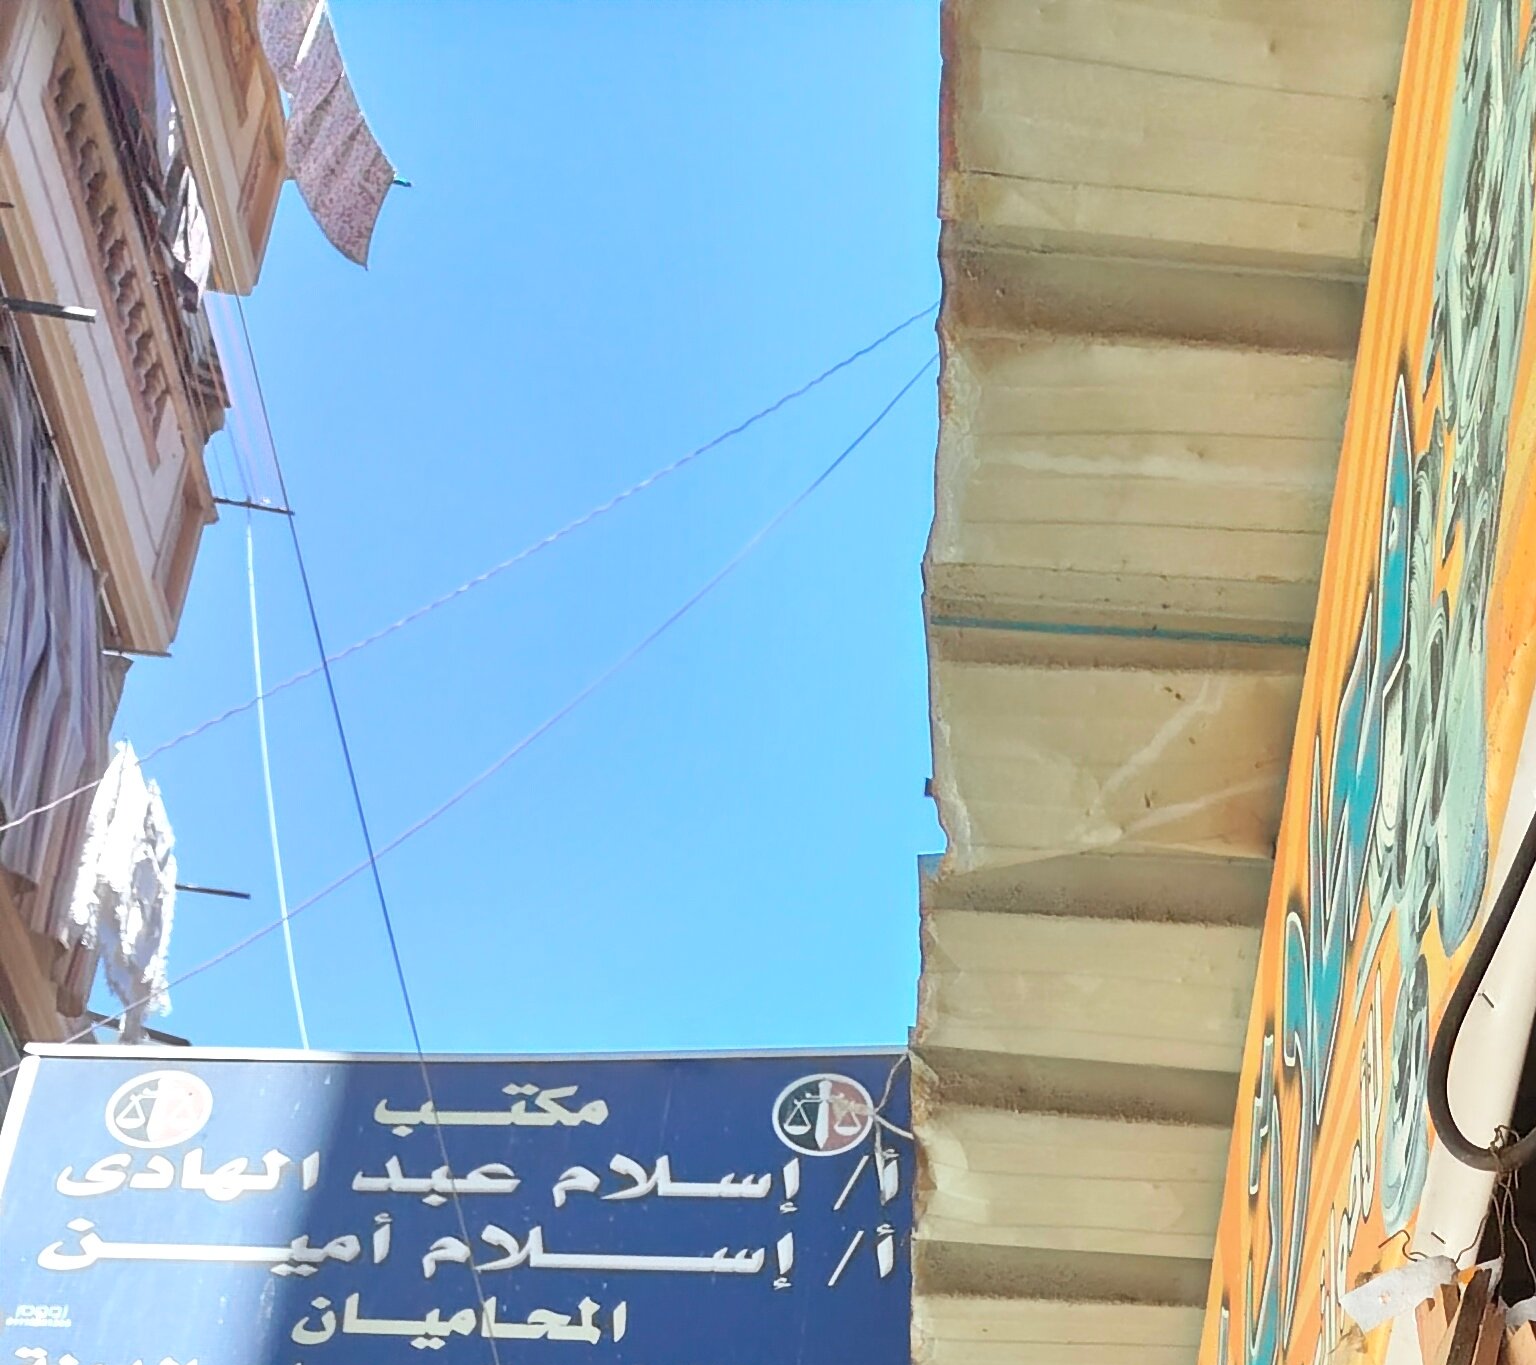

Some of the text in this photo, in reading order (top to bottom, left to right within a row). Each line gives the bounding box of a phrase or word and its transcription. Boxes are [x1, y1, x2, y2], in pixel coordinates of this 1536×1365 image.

[373, 1083, 610, 1137] مكتب
[55, 1148, 320, 1201] الهادى
[350, 1155, 520, 1207] عبد
[553, 1154, 801, 1213] إسلام
[35, 1213, 392, 1276] أمين
[421, 1222, 793, 1290] إسلام
[289, 1290, 628, 1350] المحاميان
